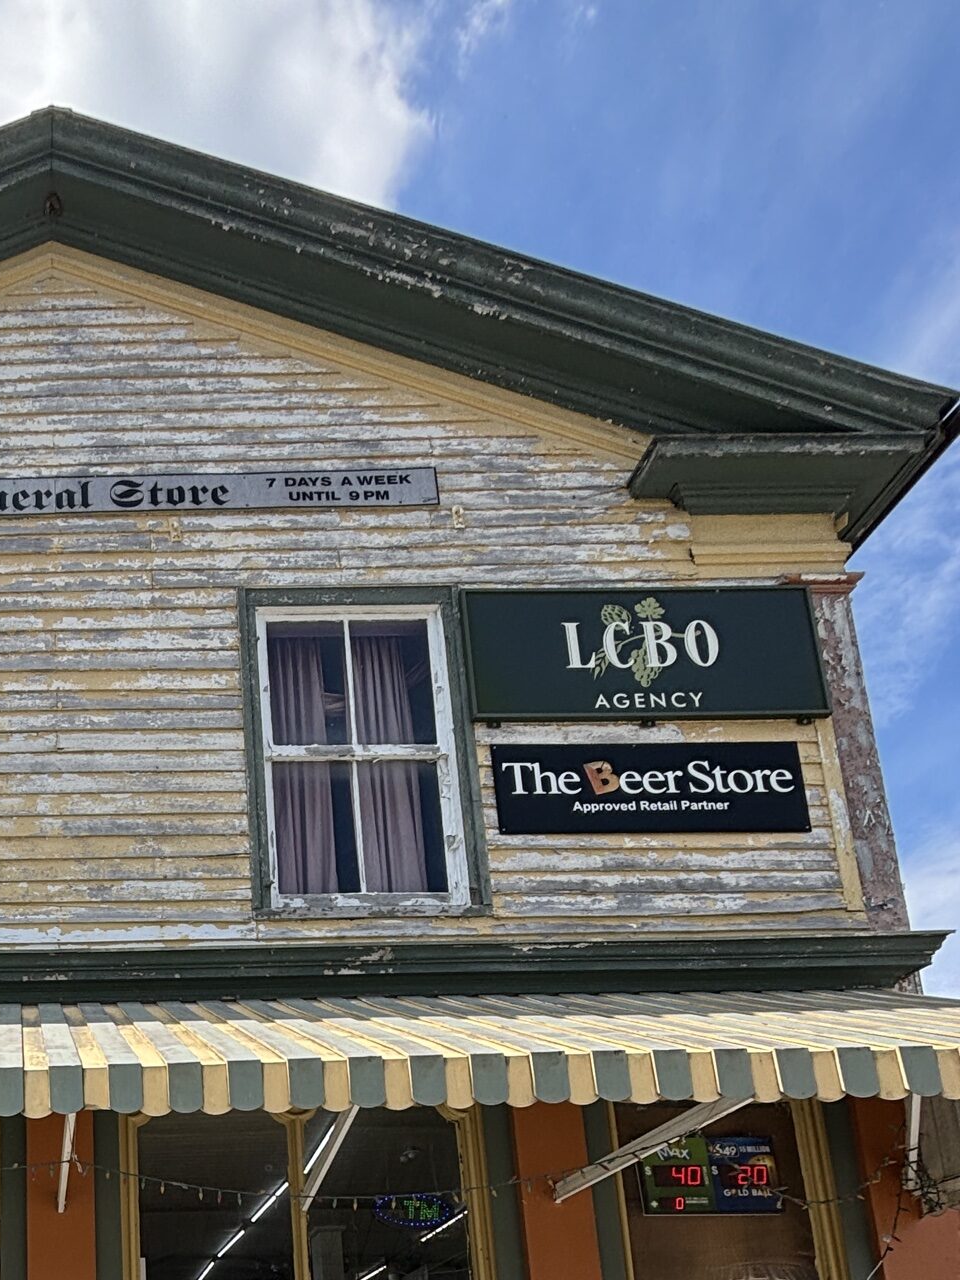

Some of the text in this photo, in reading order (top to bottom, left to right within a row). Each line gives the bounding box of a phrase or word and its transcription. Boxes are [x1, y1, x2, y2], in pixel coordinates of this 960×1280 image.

[265, 474, 412, 488] 7 DAYS A WEEK
[109, 479, 232, 508] Store
[289, 490, 390, 501] UNTIL 9 PM
[561, 619, 720, 669] LCBO
[594, 691, 703, 709] AGENCY
[502, 760, 796, 796] The Beer Store
[572, 800, 731, 814] Approved Retail Partner
[644, 1166, 652, 1176] $
[671, 1166, 701, 1185] 40
[711, 1165, 767, 1185] $ 20
[675, 1197, 684, 1210] 0
